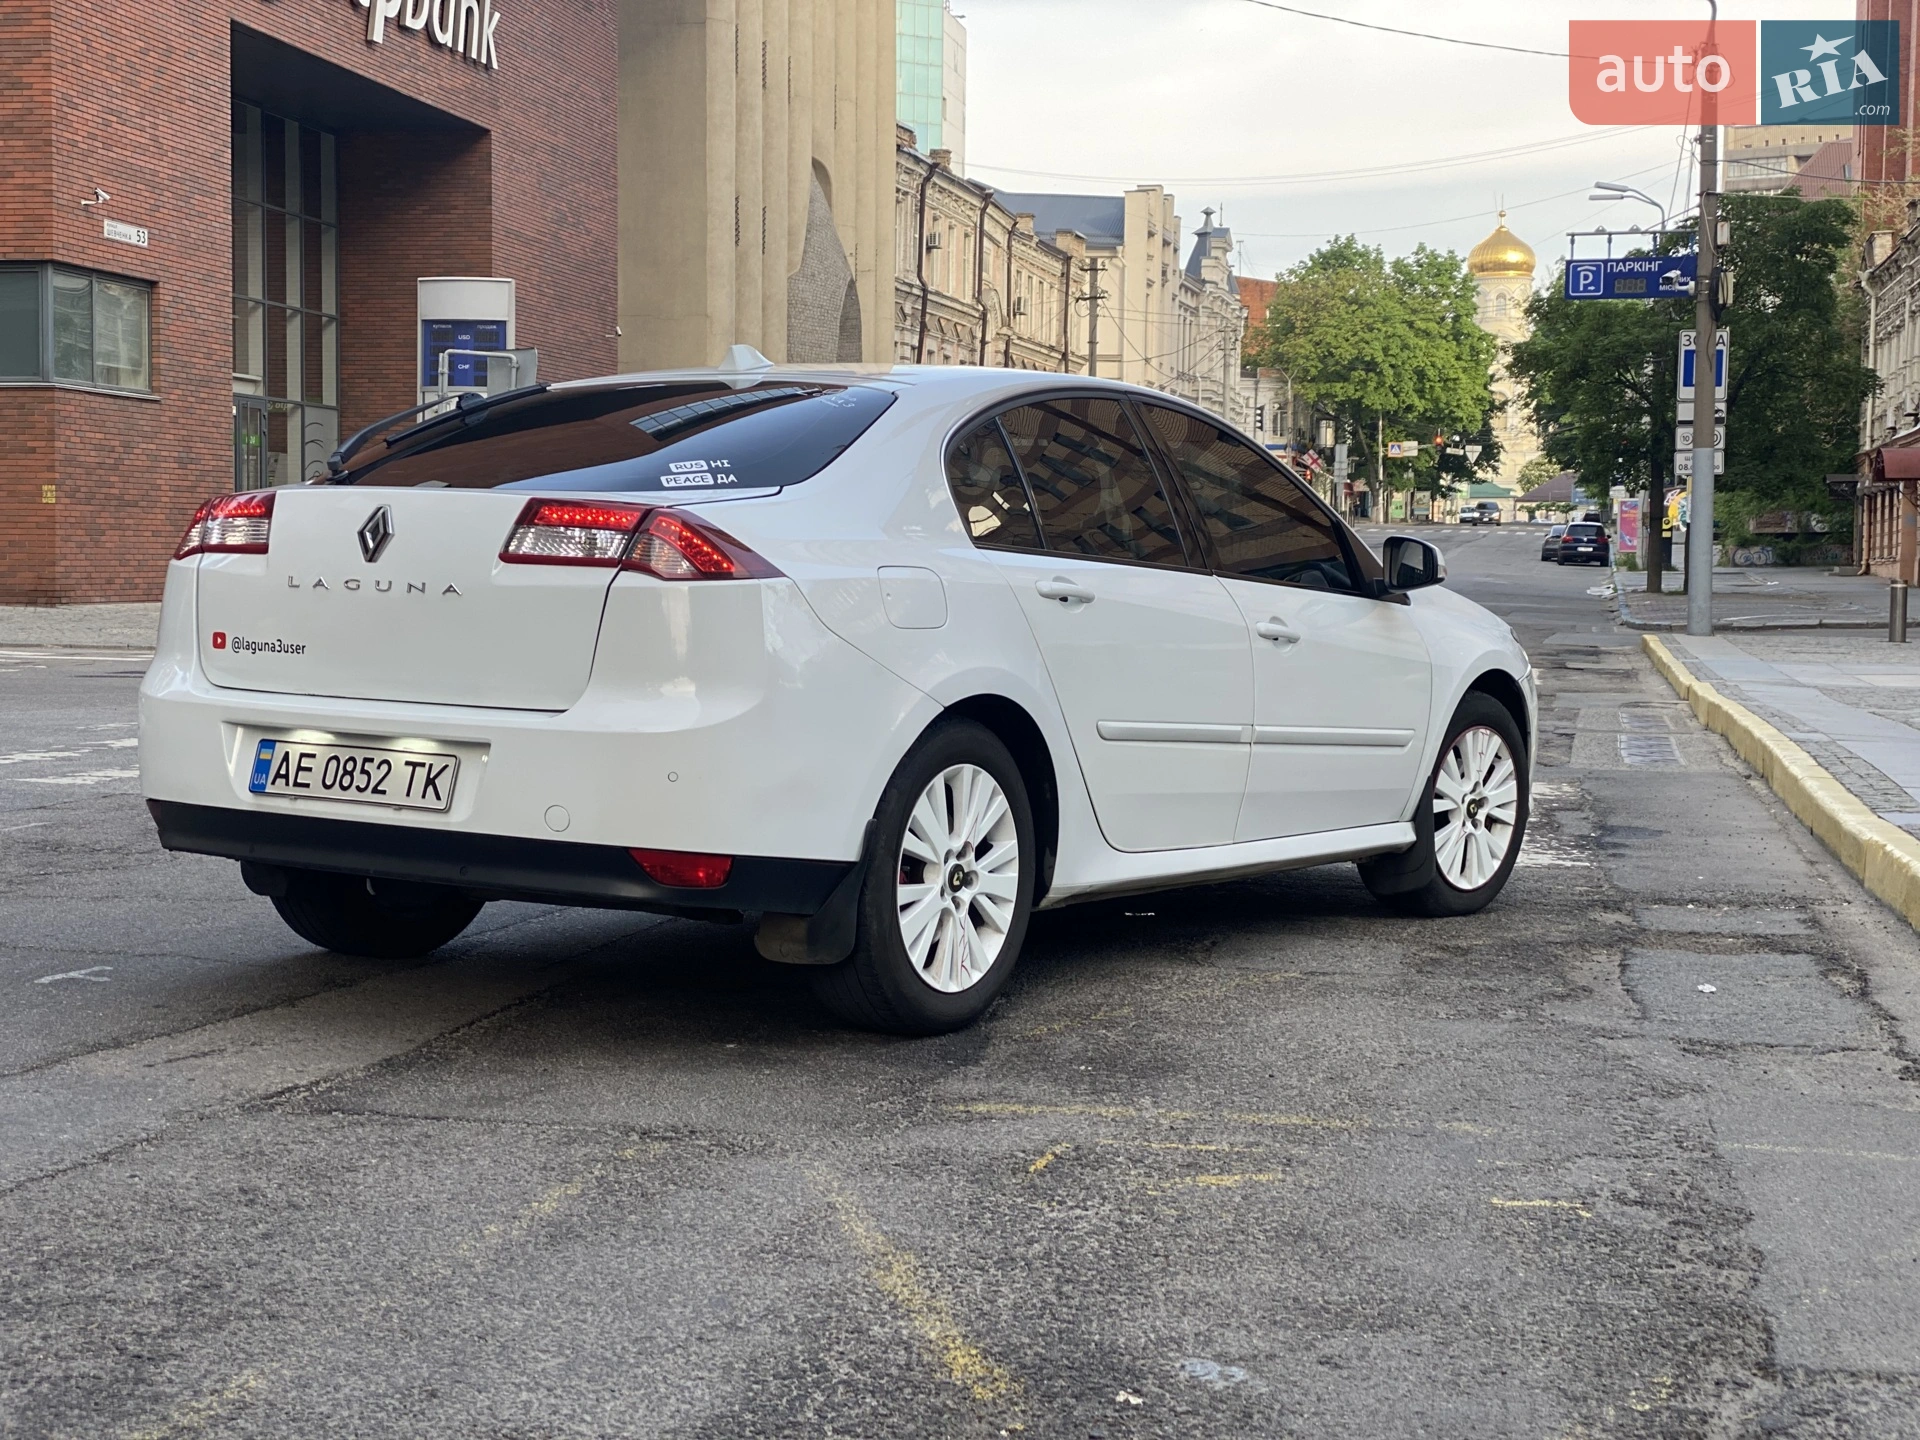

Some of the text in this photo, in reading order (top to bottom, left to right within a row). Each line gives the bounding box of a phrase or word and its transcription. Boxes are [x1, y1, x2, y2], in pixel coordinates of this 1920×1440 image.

[136, 229, 146, 244] 53
[1607, 260, 1663, 273] ПАРКІНГ
[674, 461, 704, 471] RUS
[665, 474, 710, 485] PEACE
[287, 575, 463, 597] LAGUNA
[231, 636, 306, 655] @laguna3user
[253, 773, 267, 786] UA
[270, 750, 450, 802] AE 0852 TK
